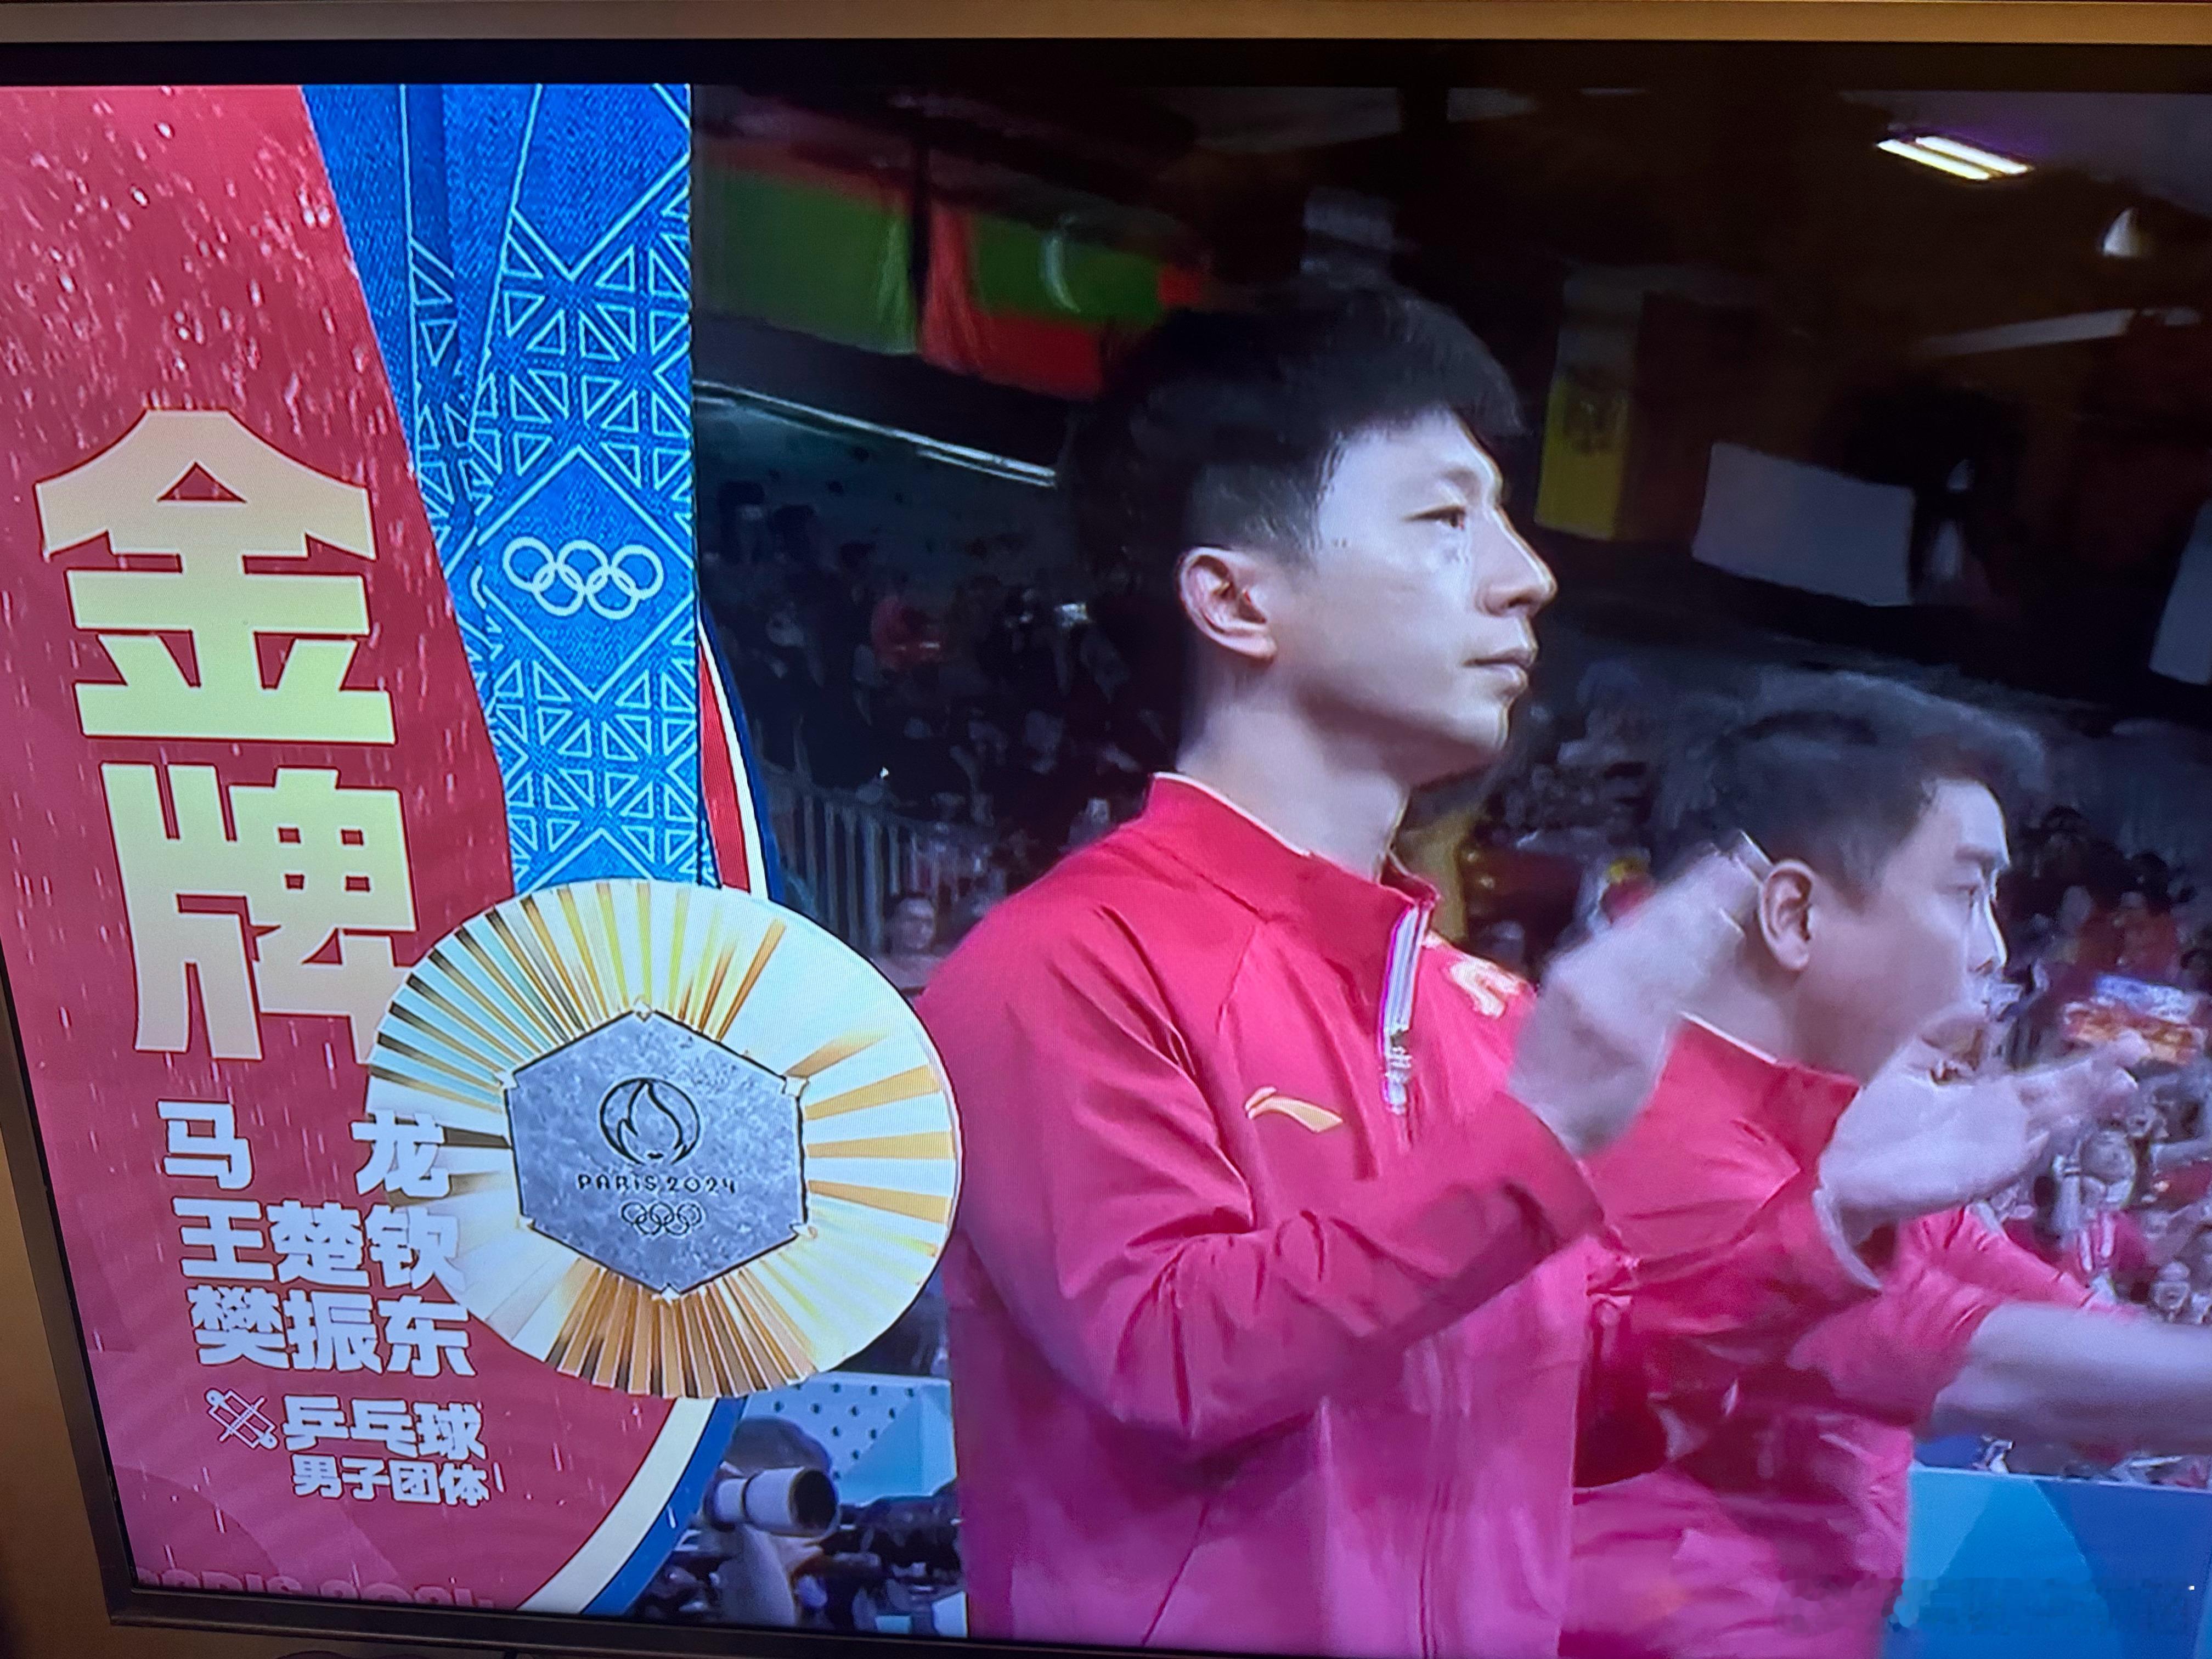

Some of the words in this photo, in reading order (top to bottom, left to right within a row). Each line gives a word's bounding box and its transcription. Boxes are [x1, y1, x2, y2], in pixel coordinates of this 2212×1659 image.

[35, 408, 417, 1064] 金牌
[157, 1101, 252, 1190] 马
[351, 1109, 452, 1198] 龙
[578, 1173, 657, 1191] PARIS
[666, 1176, 735, 1194] 2024
[173, 1196, 465, 1290] 王楚钦
[187, 1285, 477, 1378] 樊振东
[283, 1395, 487, 1460] 乒乓球
[291, 1453, 490, 1506] 男子团体
